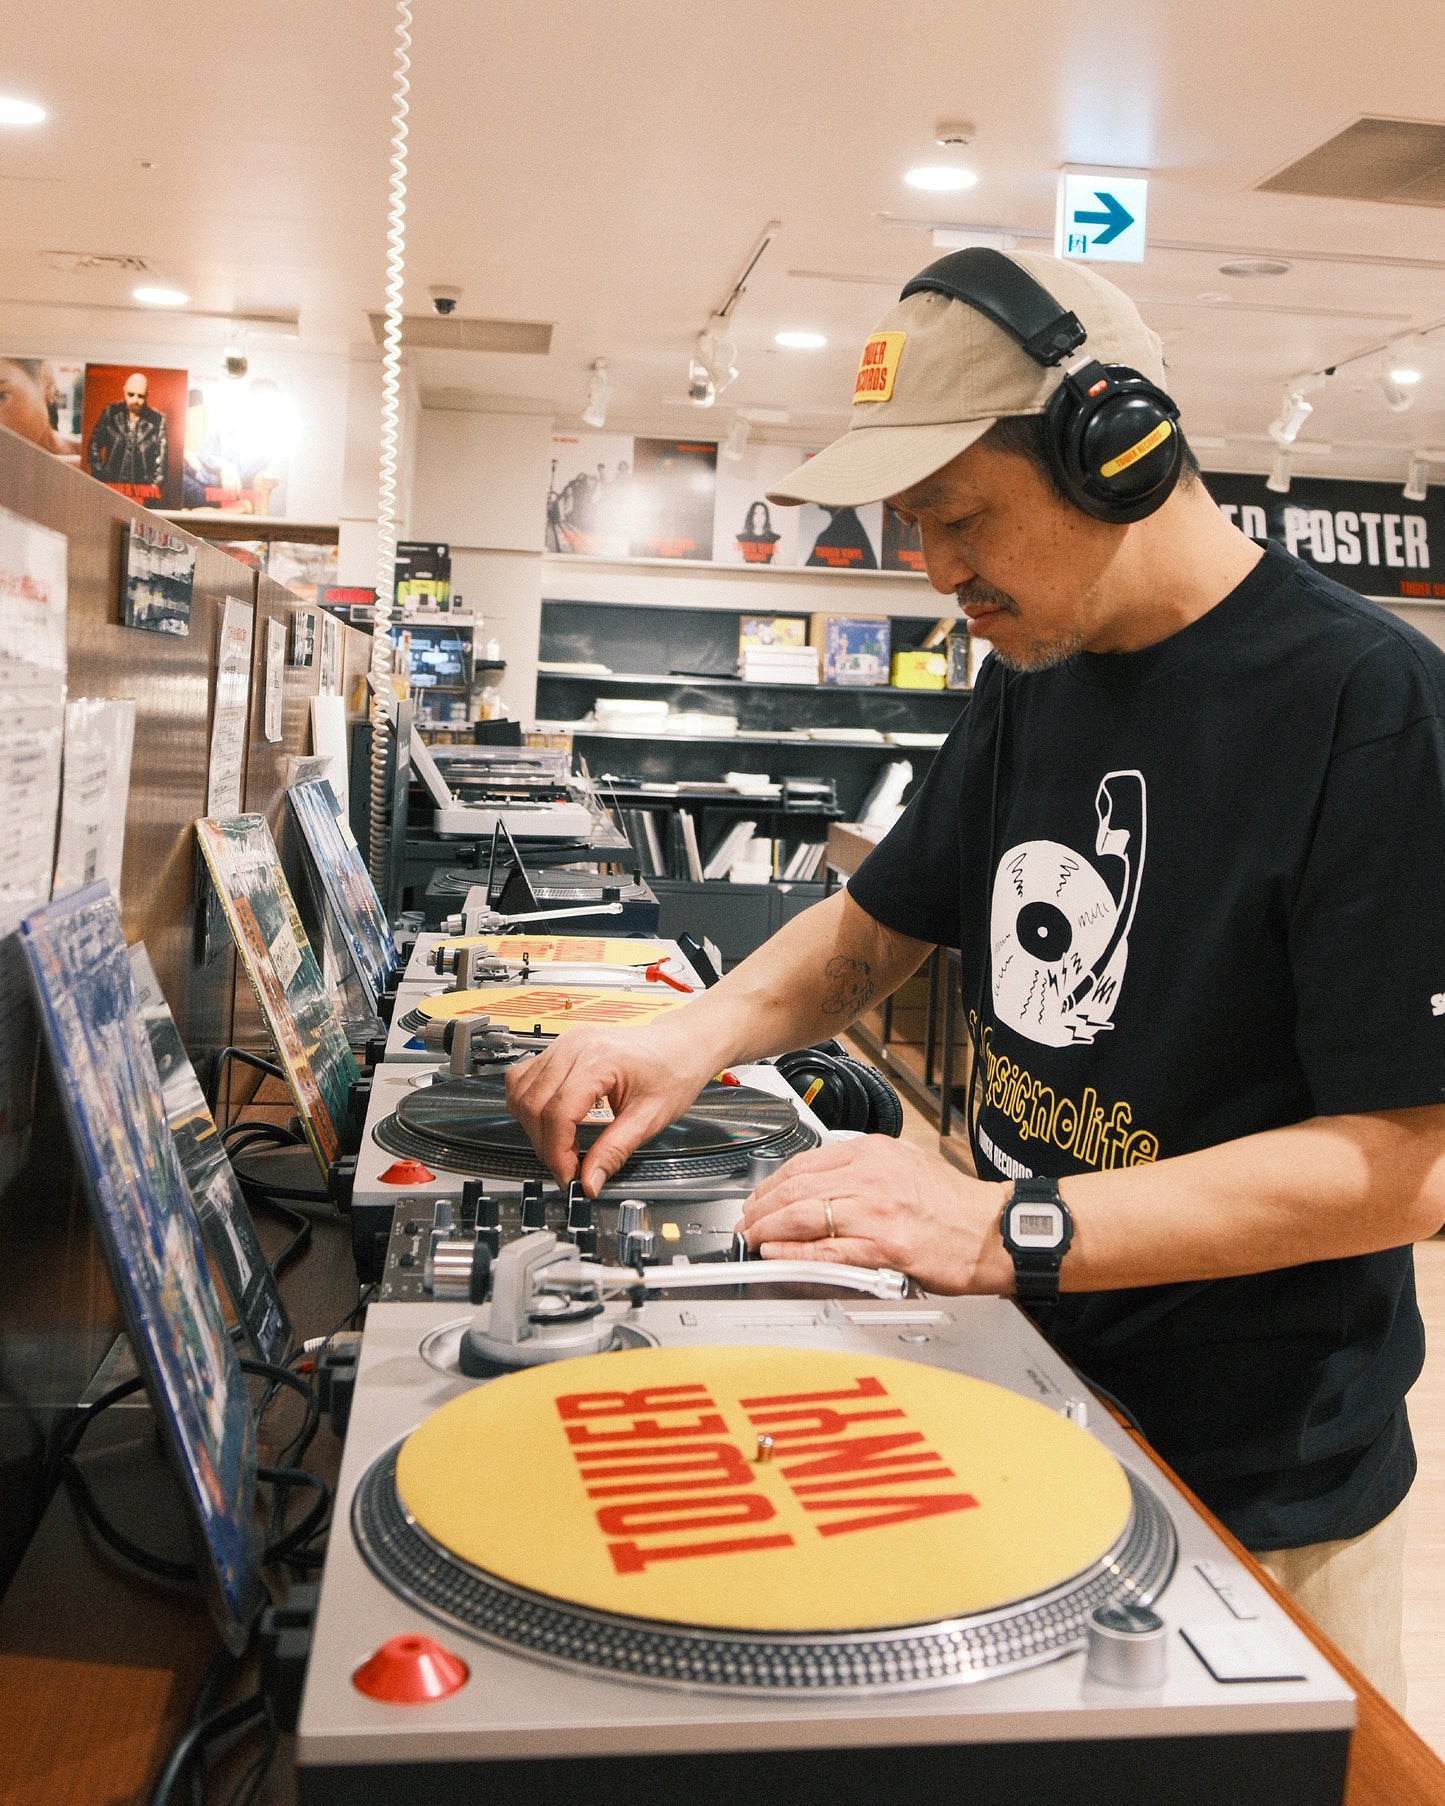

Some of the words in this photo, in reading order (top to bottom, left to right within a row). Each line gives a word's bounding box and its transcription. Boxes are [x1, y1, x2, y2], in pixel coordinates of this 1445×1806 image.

[1284, 507, 1430, 568] POSTER
[555, 1383, 797, 1577] TOWER
[738, 1376, 981, 1539] VINYL
